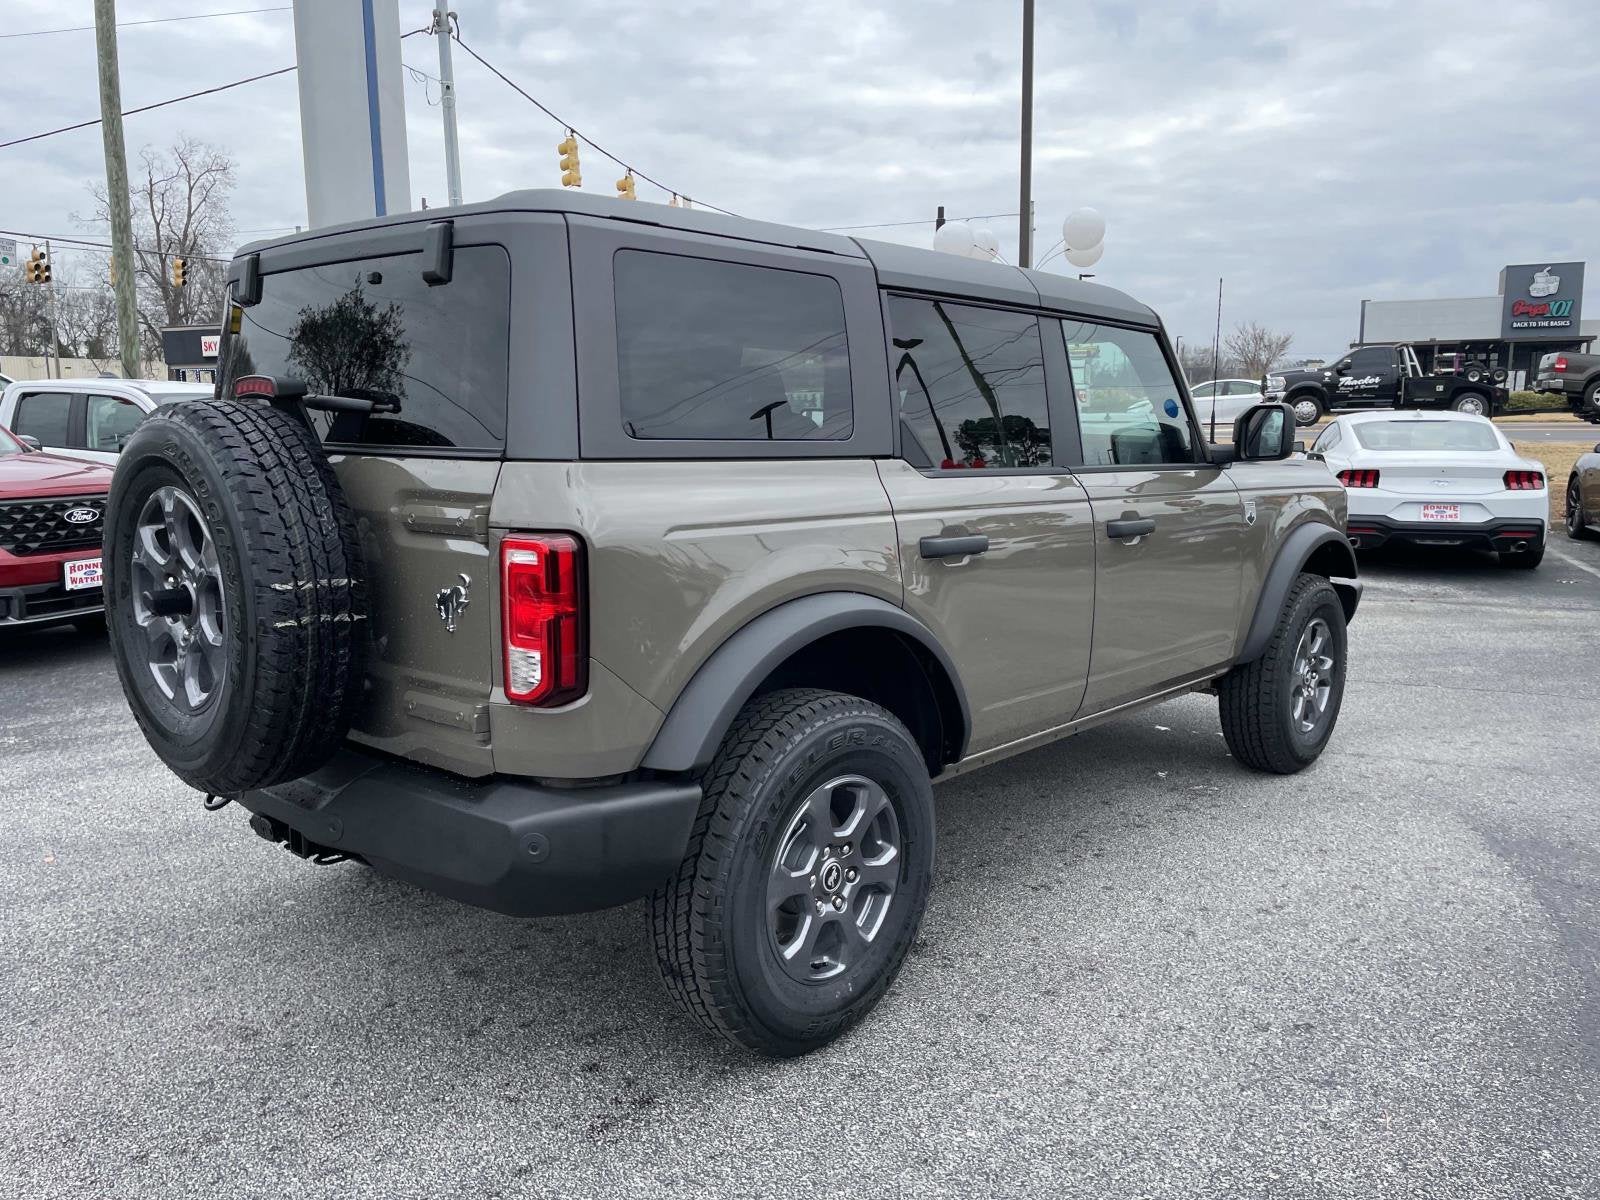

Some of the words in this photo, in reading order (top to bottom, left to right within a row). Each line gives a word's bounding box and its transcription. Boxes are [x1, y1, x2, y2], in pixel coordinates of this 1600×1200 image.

[1545, 300, 1574, 317] 101
[203, 341, 217, 351] SKY
[71, 510, 93, 521] Ford
